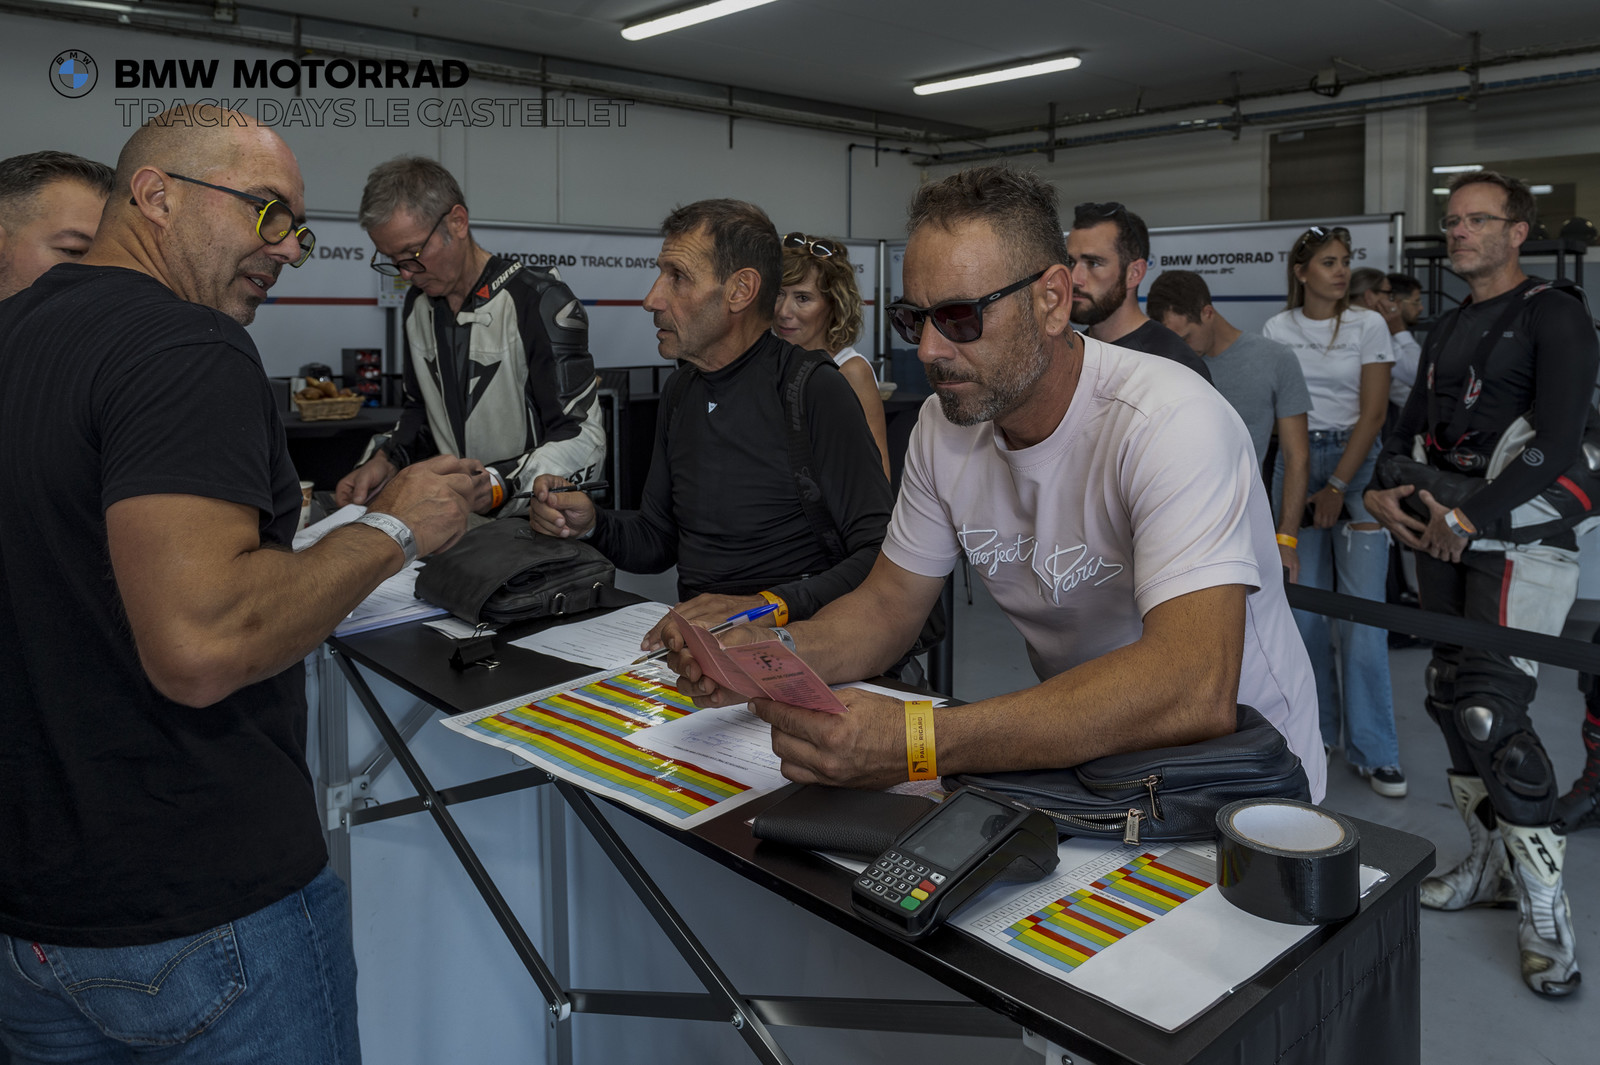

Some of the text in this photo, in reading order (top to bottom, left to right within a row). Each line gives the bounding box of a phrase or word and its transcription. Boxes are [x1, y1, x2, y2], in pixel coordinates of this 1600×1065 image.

[319, 246, 364, 260] DAYS
[1160, 255, 1192, 266] BMW
[1196, 252, 1274, 264] MOTORRAD
[581, 255, 623, 268] TRACK
[626, 257, 656, 269] DAYS
[957, 524, 1034, 576] Project
[1045, 544, 1124, 606] Paris
[760, 655, 772, 668] F
